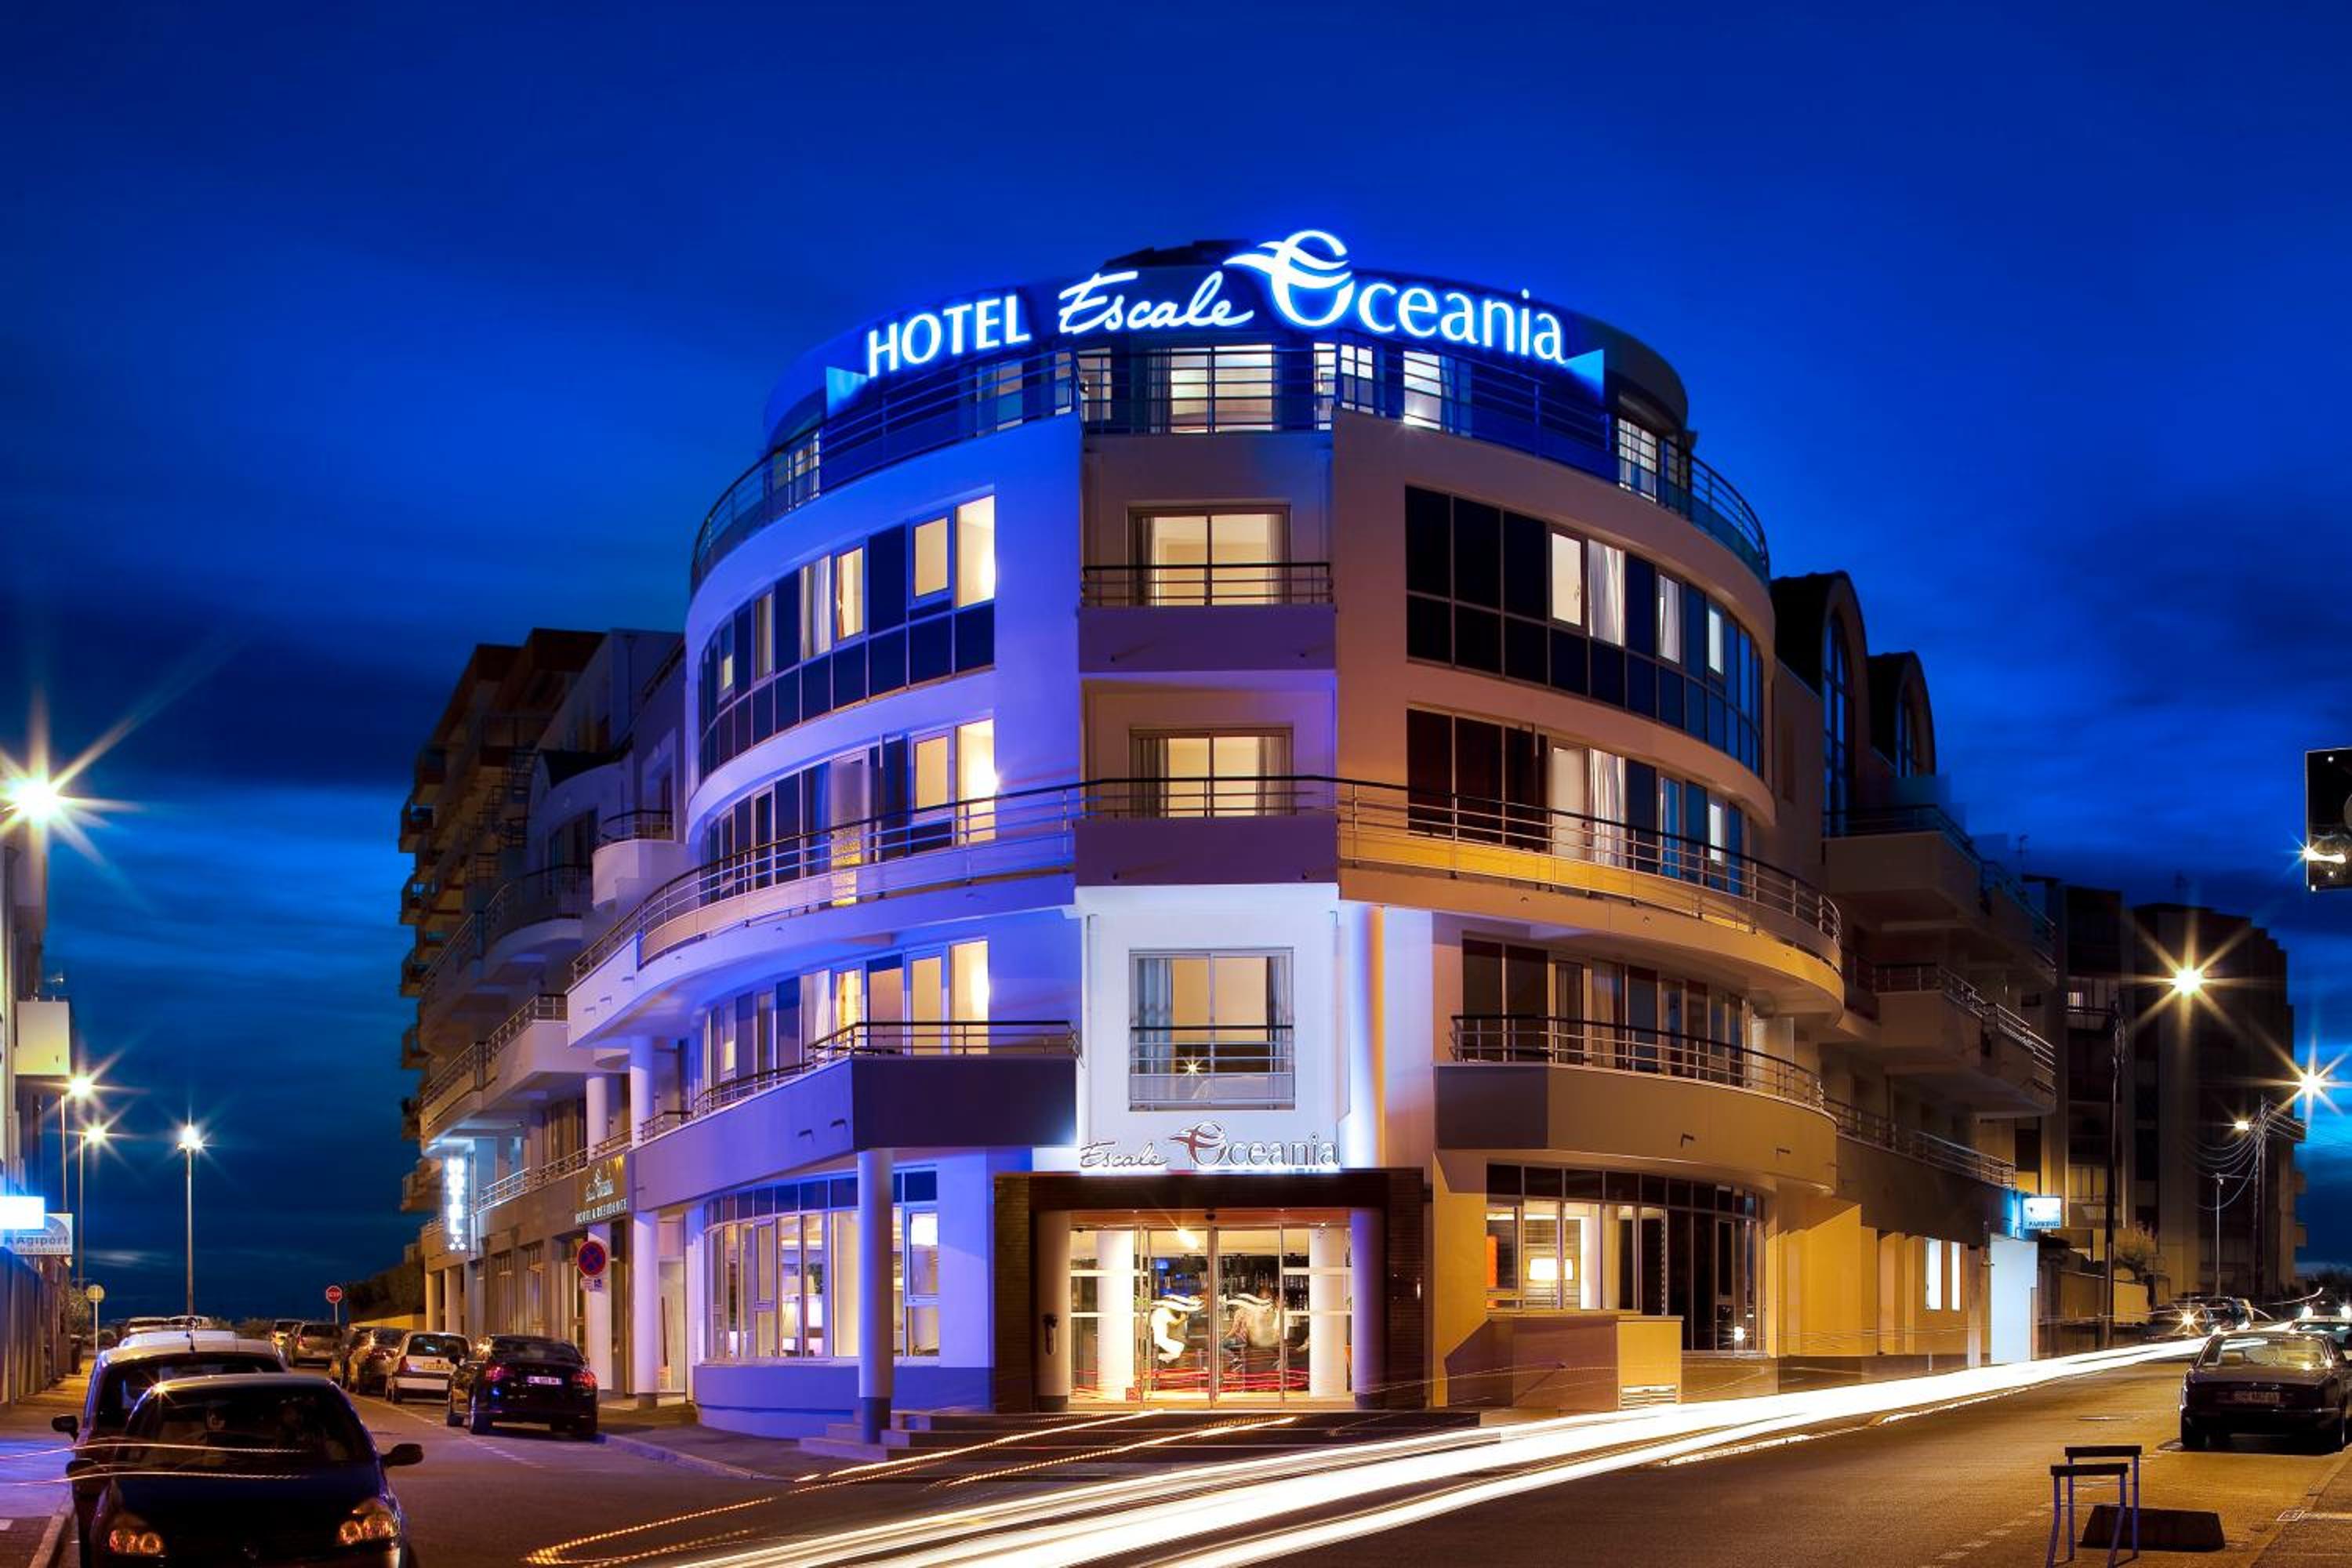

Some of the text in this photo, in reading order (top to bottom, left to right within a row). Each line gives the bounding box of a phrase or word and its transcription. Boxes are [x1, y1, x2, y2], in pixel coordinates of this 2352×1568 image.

[868, 230, 1566, 378] HOTEL Escale Oceania
[1080, 1121, 1340, 1168] Escale Oceania
